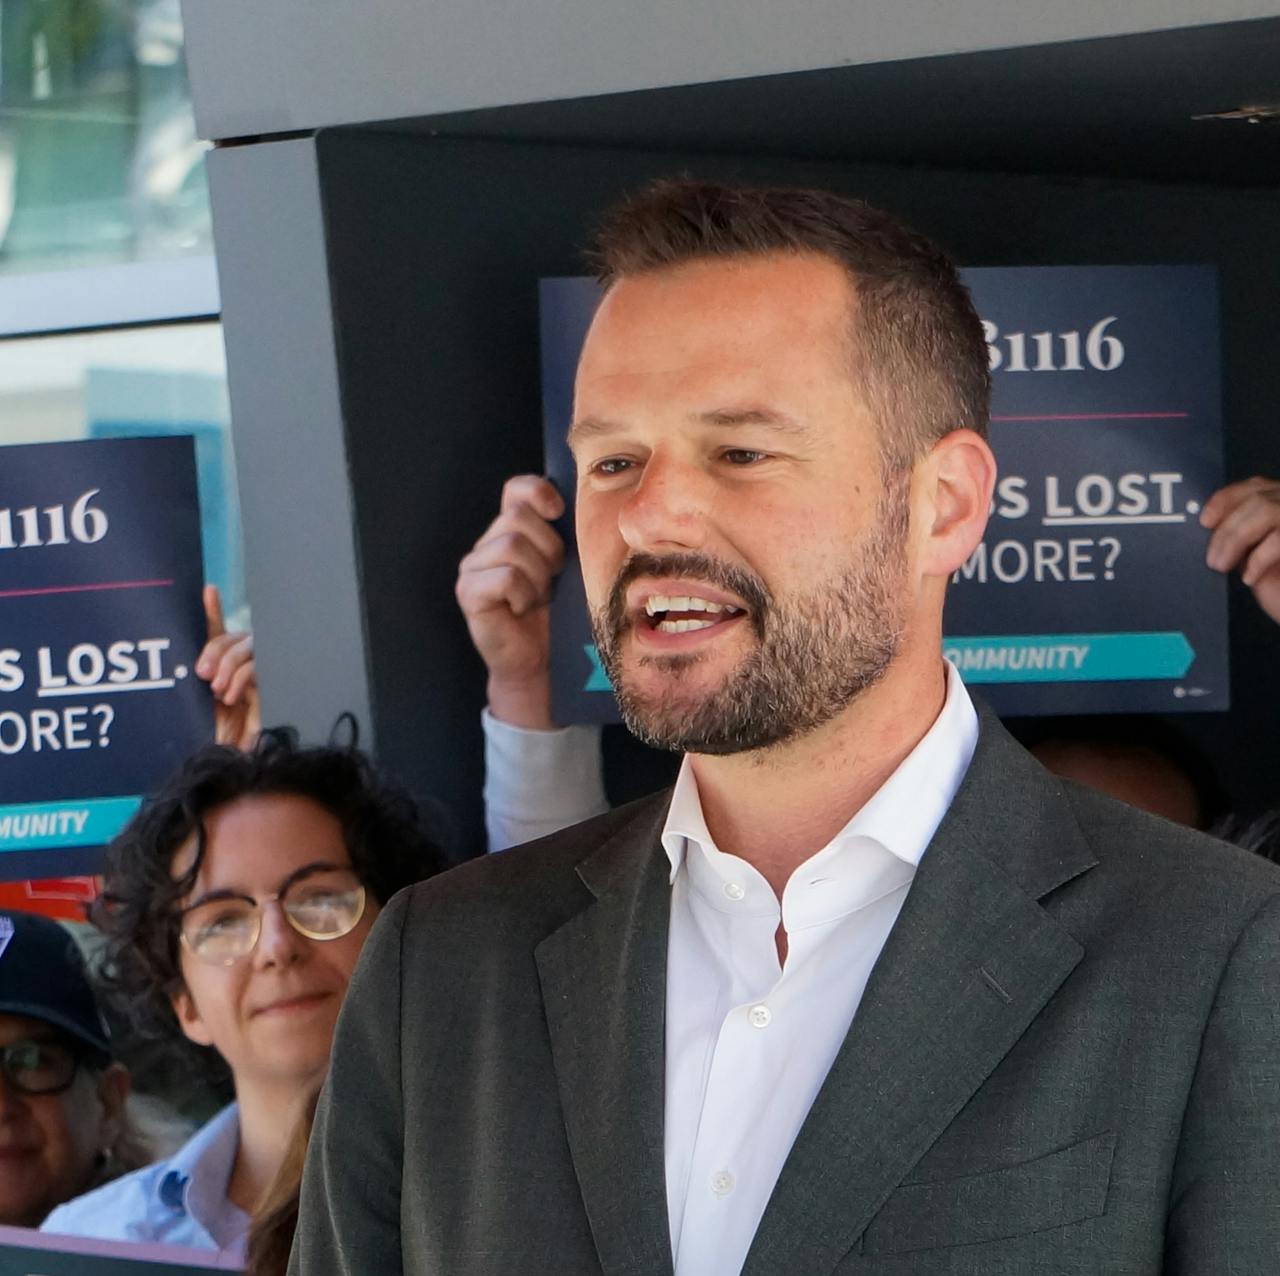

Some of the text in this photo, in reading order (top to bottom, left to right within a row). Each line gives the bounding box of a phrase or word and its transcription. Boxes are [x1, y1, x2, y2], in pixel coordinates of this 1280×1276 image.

[1044, 473, 1200, 523] LOST.
[951, 535, 1122, 586] MORE?
[37, 637, 188, 692] LOST.
